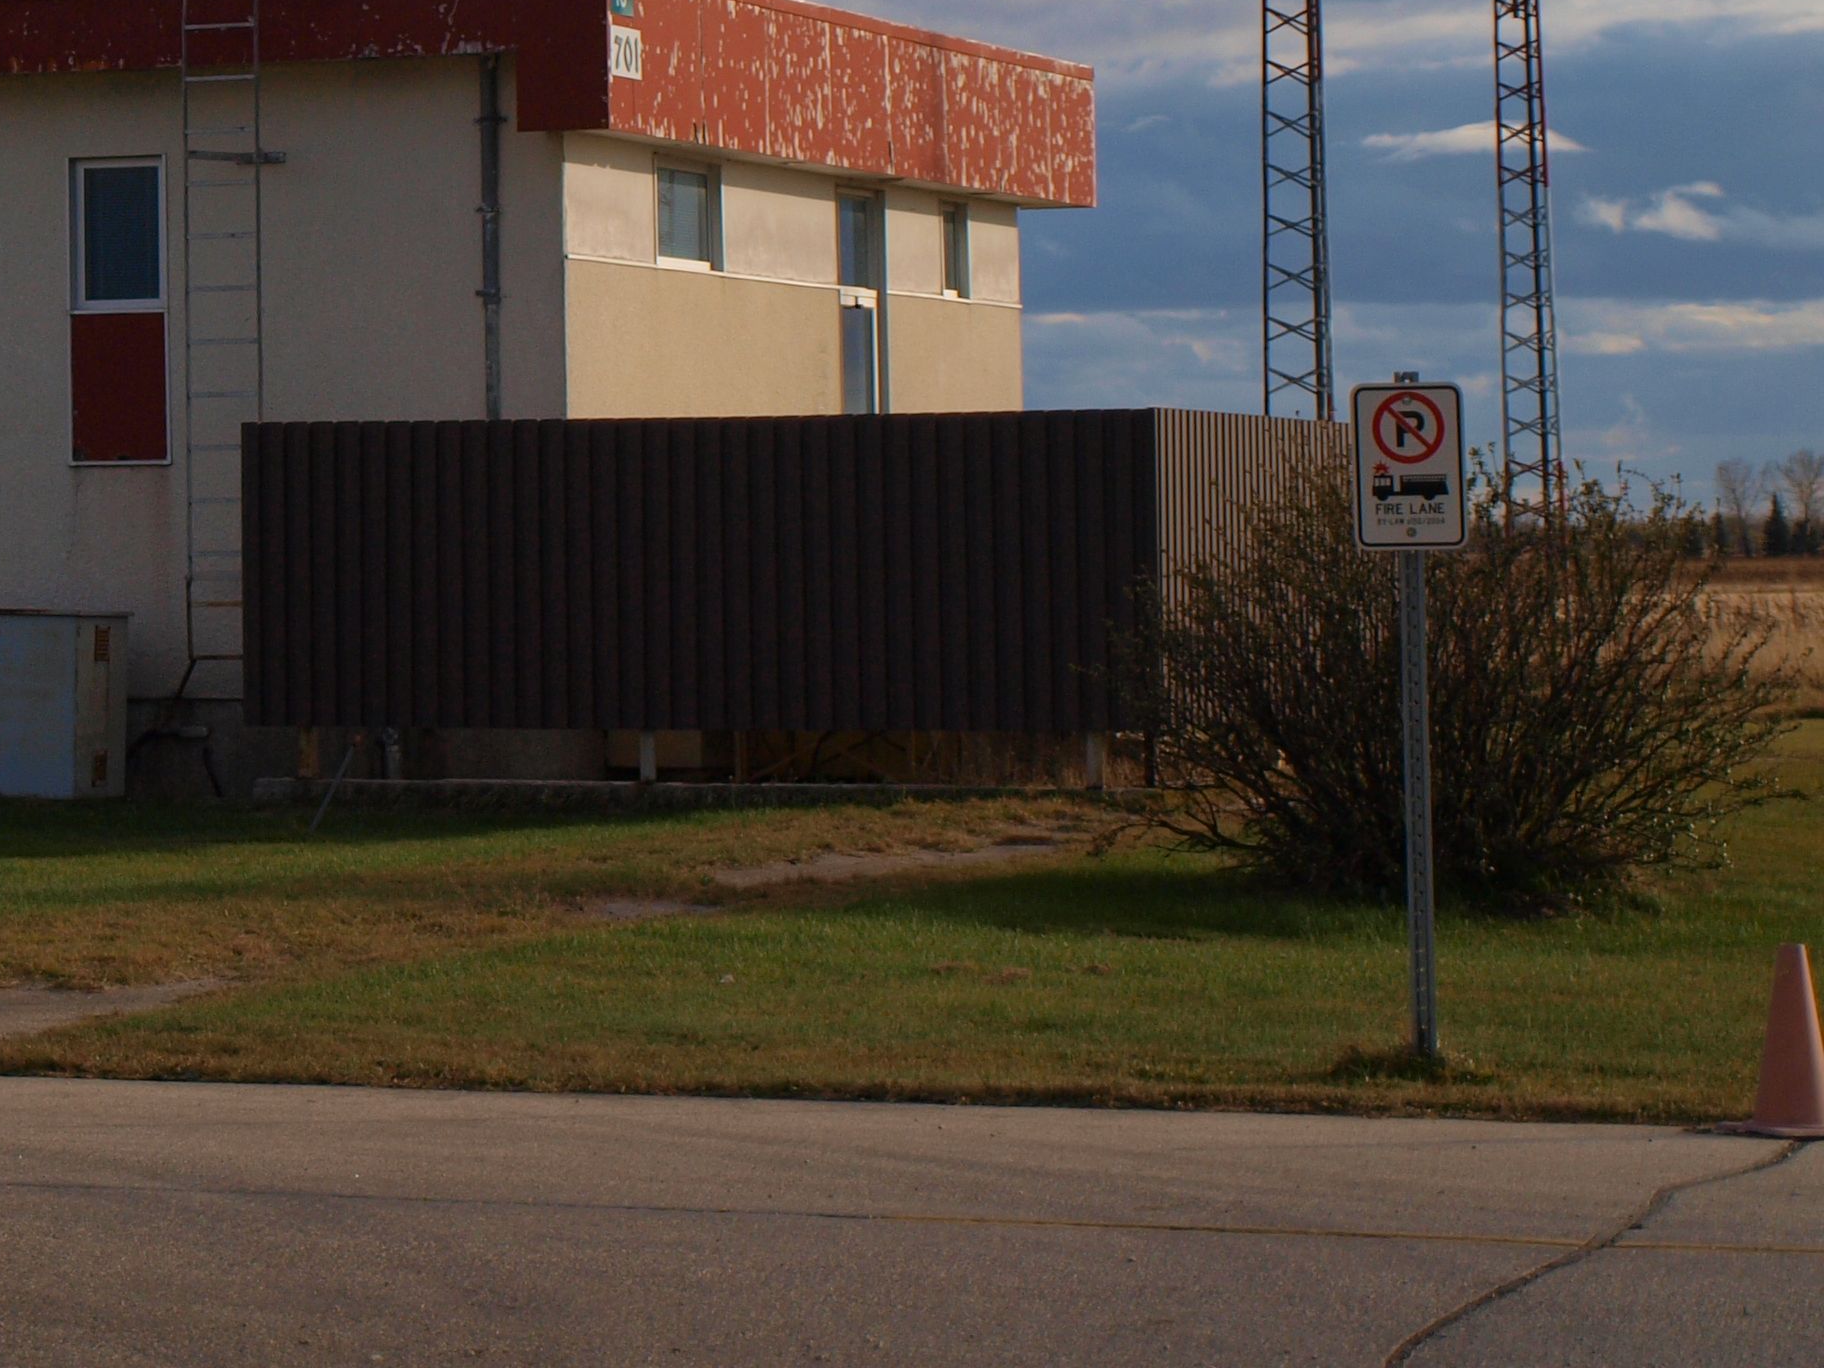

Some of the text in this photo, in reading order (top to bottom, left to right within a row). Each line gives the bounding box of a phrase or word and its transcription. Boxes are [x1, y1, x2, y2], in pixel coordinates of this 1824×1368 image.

[614, 35, 639, 73] 701
[1396, 410, 1425, 448] P
[1375, 502, 1446, 515] FIRE LANE
